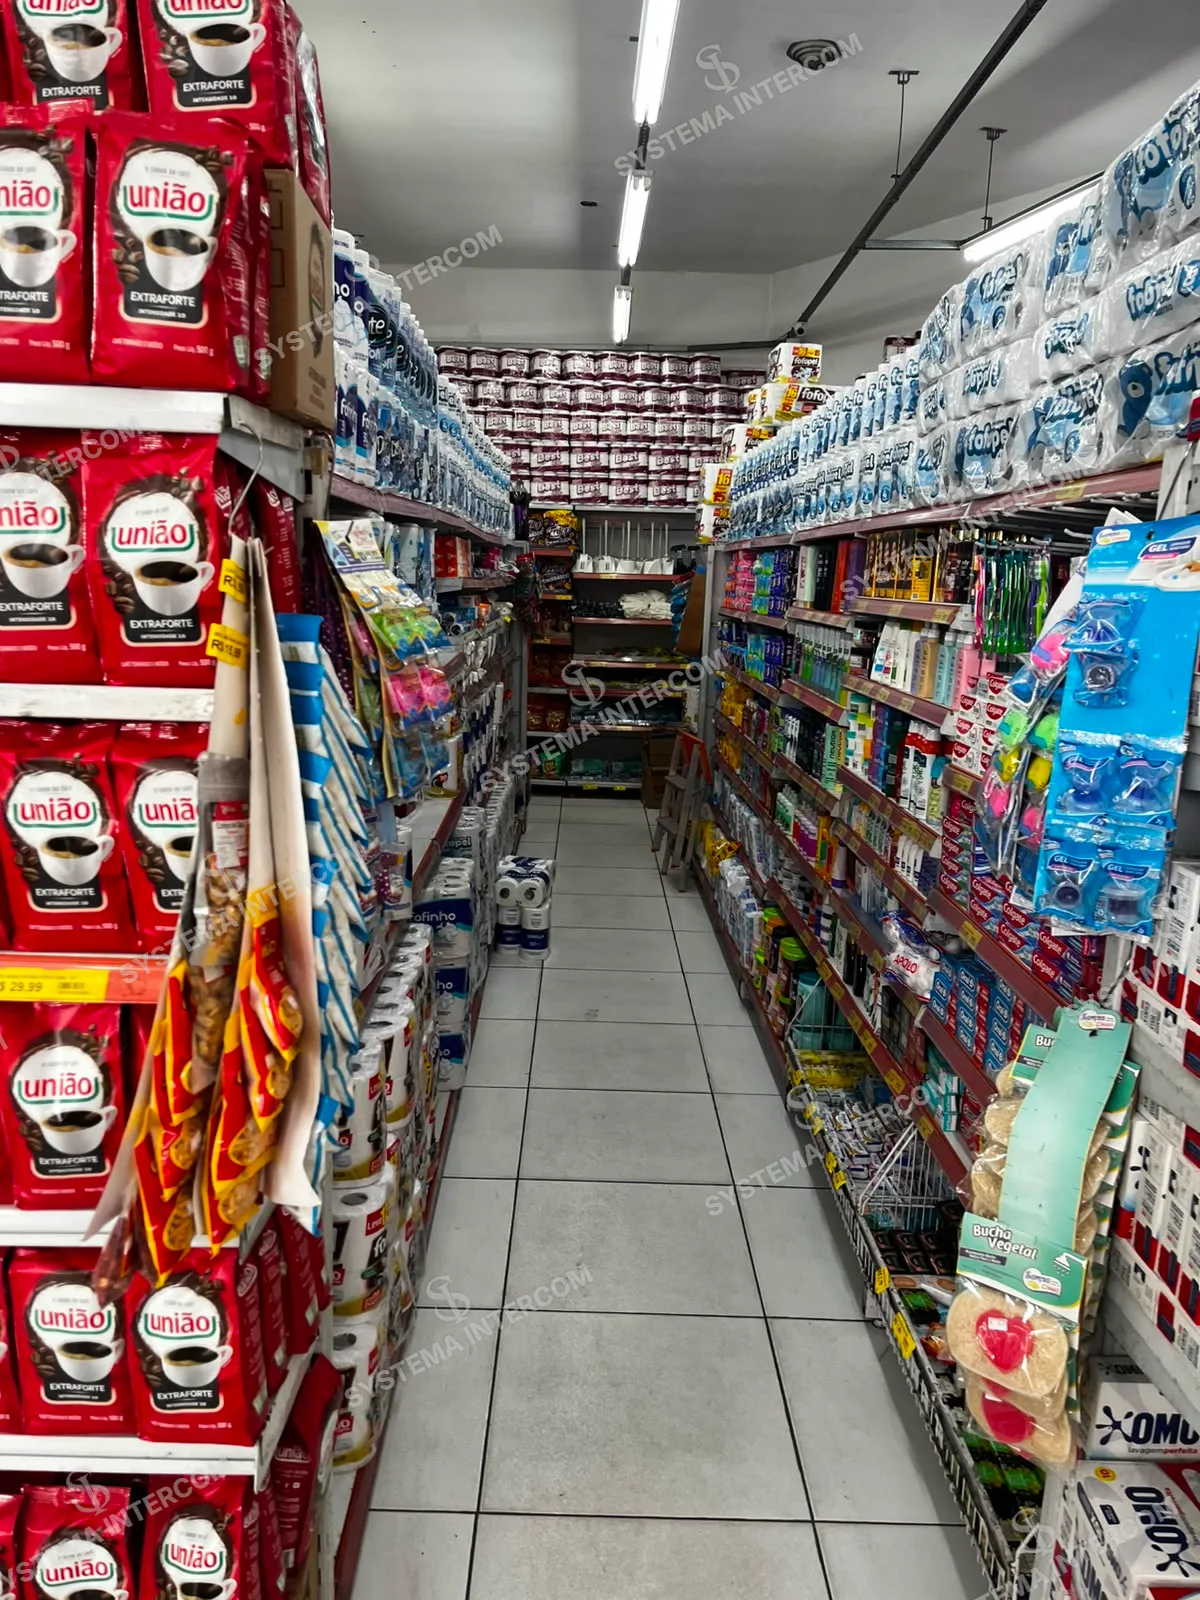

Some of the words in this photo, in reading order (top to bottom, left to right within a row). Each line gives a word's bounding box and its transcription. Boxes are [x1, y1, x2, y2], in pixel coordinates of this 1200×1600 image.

[42, 86, 103, 98] EXTRAFORTE
[182, 79, 245, 93] EXTRAFORTE
[128, 181, 207, 214] união
[0, 291, 50, 303] TRAFORTE
[130, 291, 197, 308] EXTRAFORTE
[793, 356, 819, 367] fofopel
[785, 388, 798, 399] 16
[659, 421, 678, 433] Best
[687, 422, 706, 433] Best
[537, 450, 561, 464] Best
[577, 450, 601, 465] Best
[614, 450, 639, 465] Best
[656, 453, 681, 467] Best
[537, 478, 561, 492] Best
[718, 472, 730, 485] 16
[577, 479, 601, 495] Best
[615, 480, 639, 496] Best
[653, 481, 678, 496] Best
[713, 491, 727, 503] 15
[0, 501, 58, 527] nião
[117, 520, 188, 546] união
[1148, 543, 1169, 553] GEL
[0, 602, 64, 612] EXTRAFORTE
[129, 618, 195, 630] EXTRAFORTE
[20, 797, 91, 822] união
[145, 798, 199, 822] uniã
[942, 818, 961, 836] Colgate
[444, 836, 472, 849] opel
[942, 836, 960, 854] Colgate
[941, 855, 960, 872] Colgate
[1053, 854, 1069, 864] GEL
[1107, 863, 1125, 874] GEL
[939, 873, 958, 893] Colgate
[972, 879, 993, 901] Colgate
[35, 887, 96, 898] EXTRAFORTE
[970, 899, 989, 921] Colgate
[1003, 903, 1026, 926] Colgate
[1001, 924, 1022, 948] Colgate
[1039, 931, 1063, 956] Colgate
[893, 955, 919, 974] APOLO
[1032, 953, 1056, 979] Colgate
[25, 1072, 92, 1098] união
[39, 1155, 98, 1166] EXTRAFORTE
[973, 1223, 1012, 1240] Bucha
[987, 1237, 1038, 1261] Vegetal
[40, 1308, 105, 1329] união
[150, 1312, 211, 1334] união
[49, 1383, 105, 1393] EXTRAFORTE
[157, 1390, 214, 1401] EXTRAFORTE
[1124, 1486, 1188, 1545] OMO
[169, 1543, 218, 1569] união
[46, 1559, 109, 1582] união
